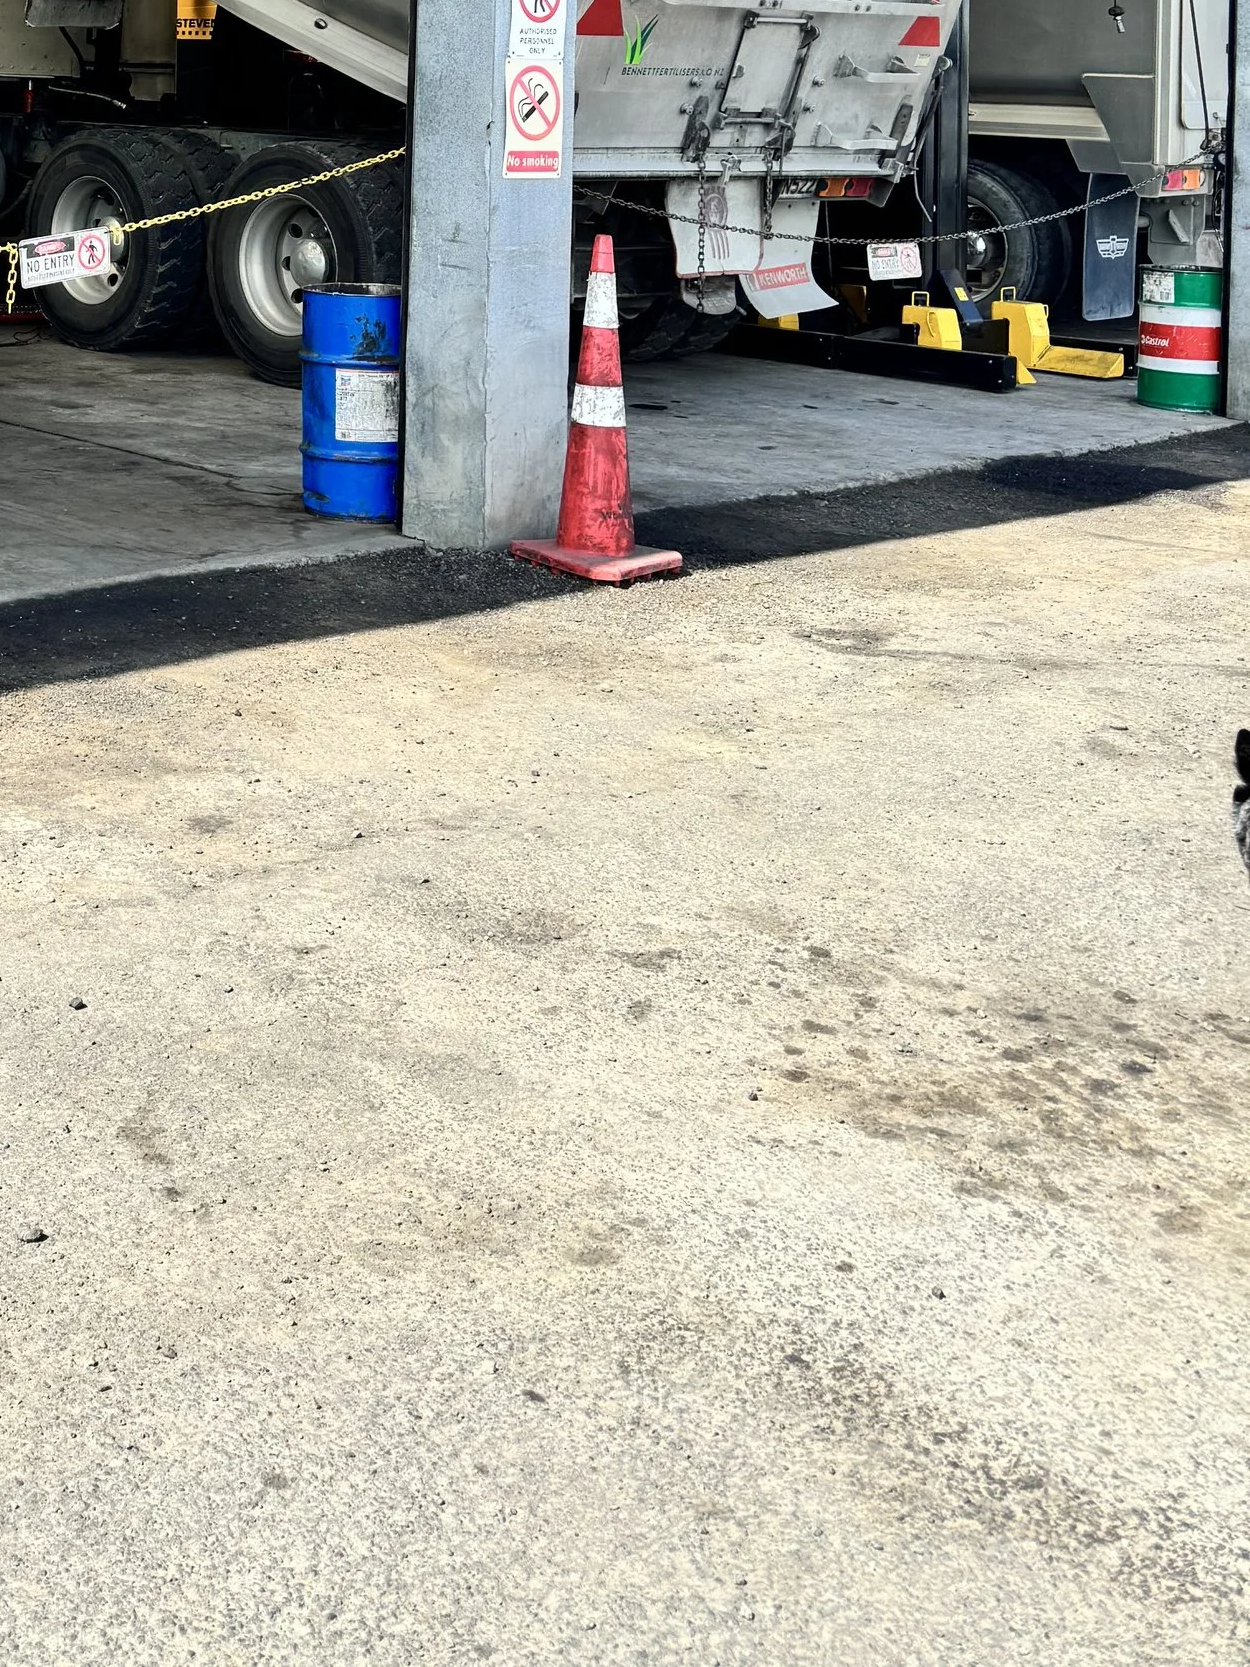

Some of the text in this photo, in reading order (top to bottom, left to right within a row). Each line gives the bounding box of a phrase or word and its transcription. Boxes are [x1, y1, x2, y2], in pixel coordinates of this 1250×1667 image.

[519, 37, 554, 45] PERSONNEL
[507, 154, 559, 170] No smoking
[27, 254, 75, 274] NO ENTRY
[758, 267, 808, 287] KENWORTH
[1145, 335, 1170, 348] Castrol
